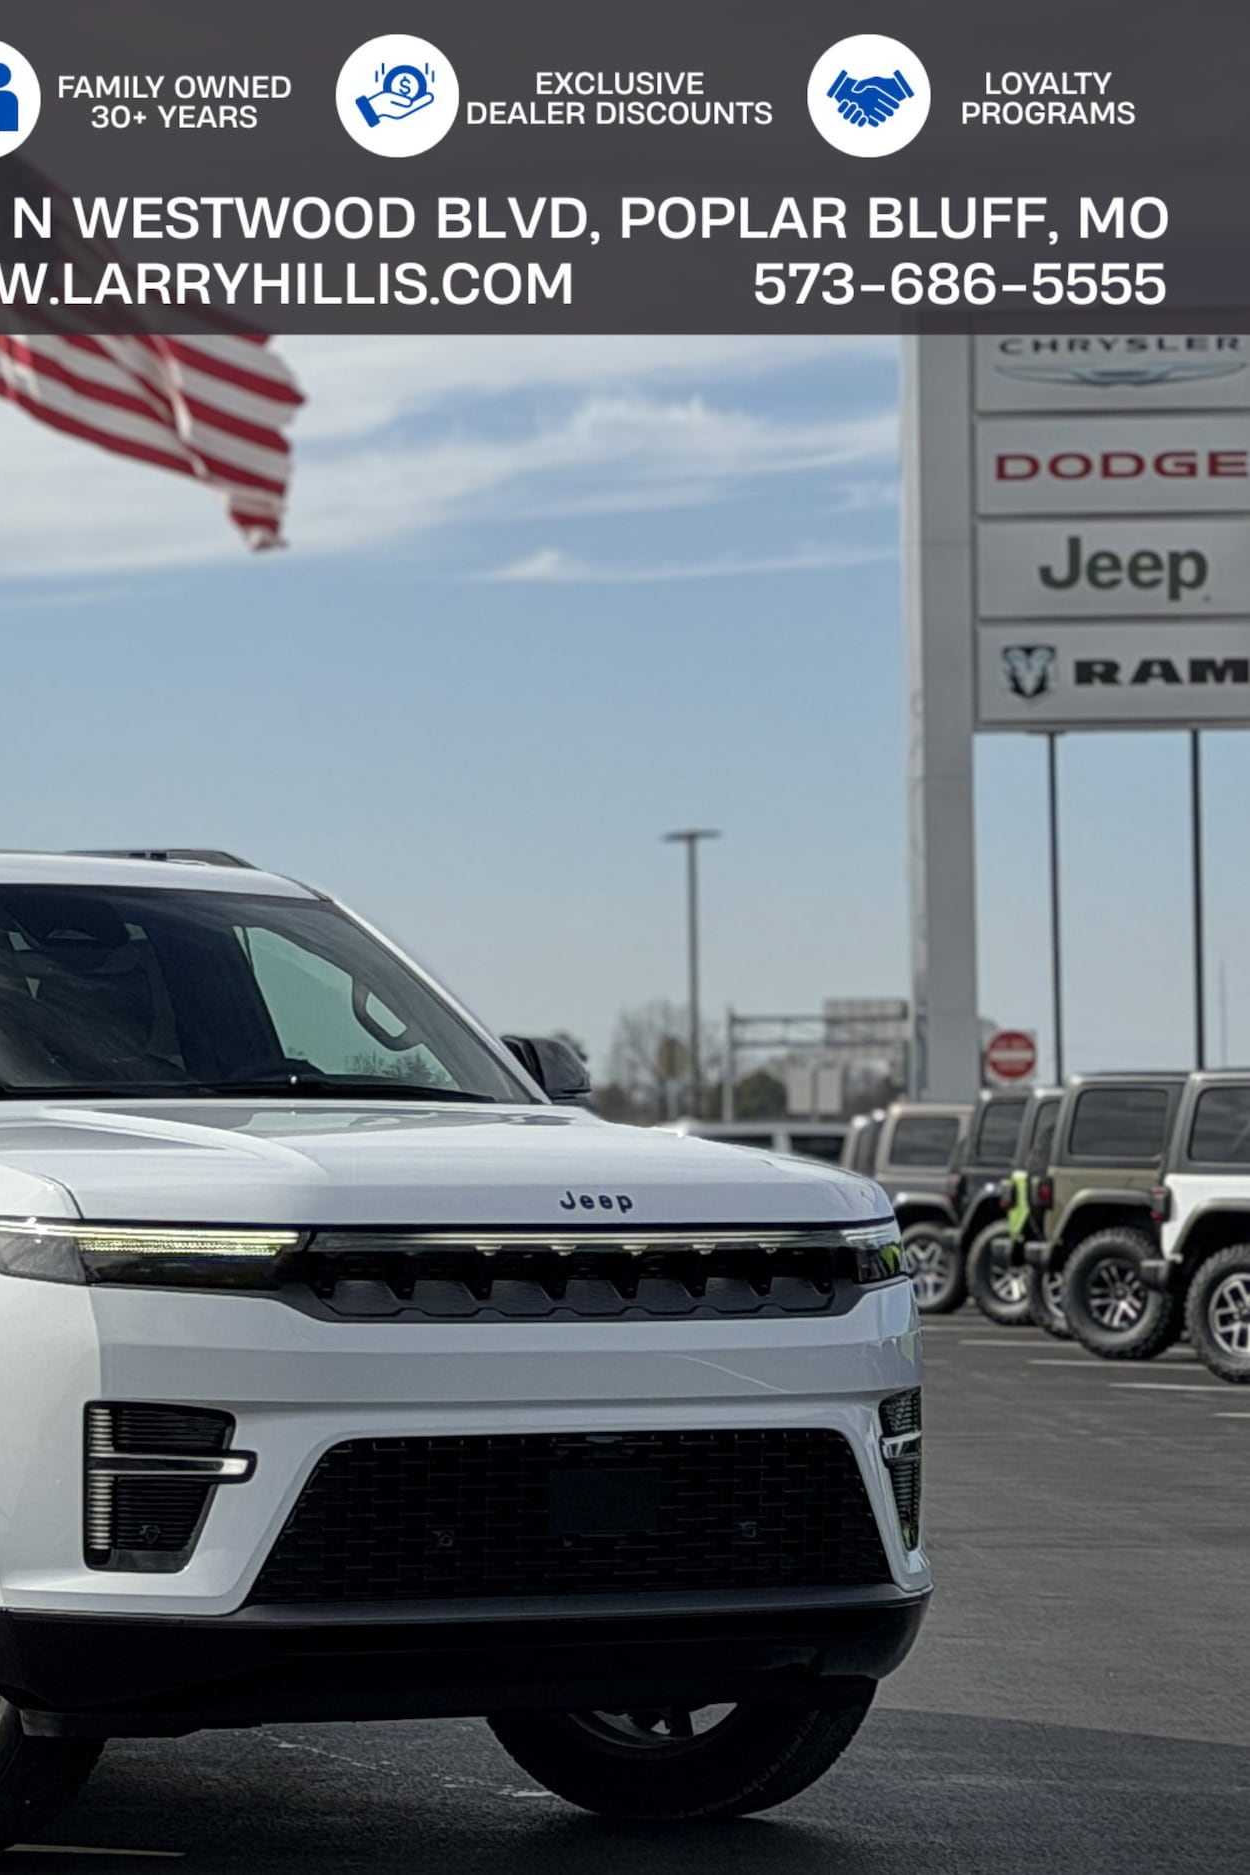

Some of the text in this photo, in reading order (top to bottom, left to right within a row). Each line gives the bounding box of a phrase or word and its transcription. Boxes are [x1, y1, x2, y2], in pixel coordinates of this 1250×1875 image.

[999, 337, 1240, 355] CHRYSLER
[995, 451, 1249, 481] DODGE
[1039, 536, 1208, 602] Jeep
[1074, 658, 1250, 686] RAM
[559, 1190, 633, 1214] Jeep
